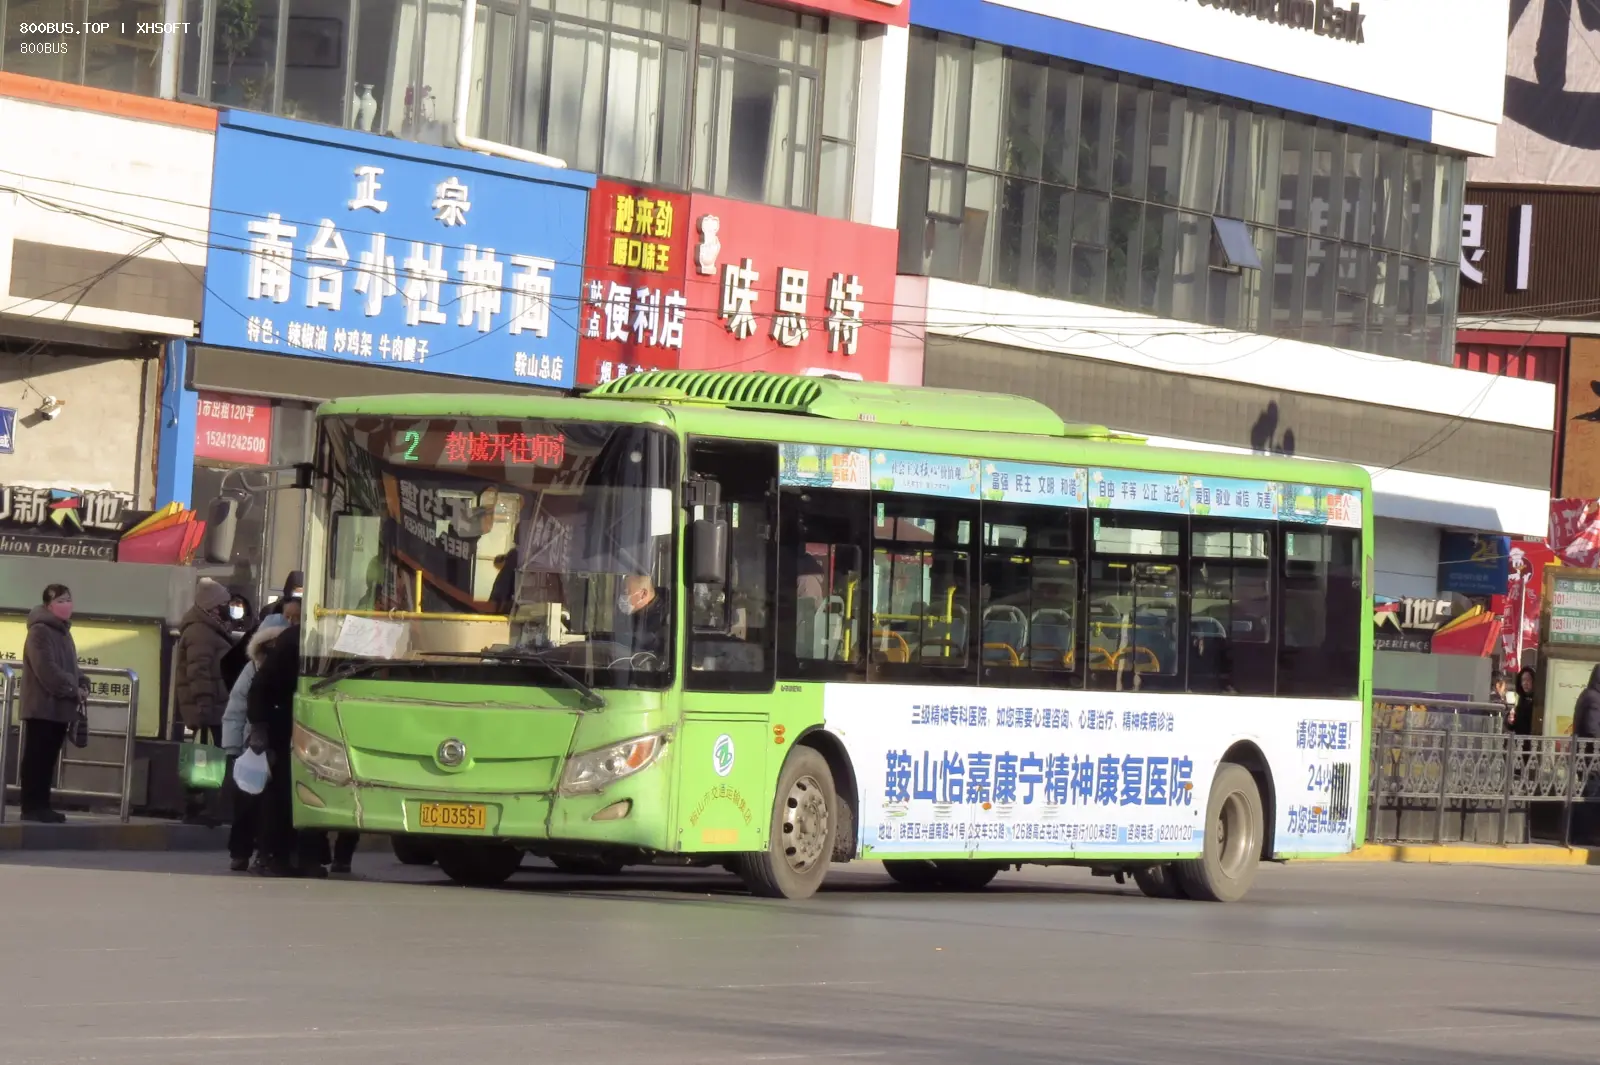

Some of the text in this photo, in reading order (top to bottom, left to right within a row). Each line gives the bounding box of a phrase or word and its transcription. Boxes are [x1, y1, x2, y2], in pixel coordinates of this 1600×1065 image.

[348, 165, 471, 227] 正宗
[246, 213, 557, 338] 南台小杜抻面
[586, 280, 603, 338] 站点
[605, 281, 687, 348] 便利店
[718, 257, 865, 355] 味思特
[287, 321, 328, 352] 辣椒油
[333, 327, 373, 357] 炒鸡架
[514, 351, 564, 381] 鞍山总店
[206, 430, 266, 453] 15241242500
[404, 431, 420, 461] 2
[892, 460, 962, 480] 社会主义核心价值观
[992, 472, 1076, 496] 富强 民主 文明 和谐
[1099, 481, 1179, 502] 自由 平等 公正 法治
[1195, 487, 1271, 509] 爱国 敬业 诚信 友善
[884, 749, 1194, 806] 鞍山怡嘉康宁精神康复医院
